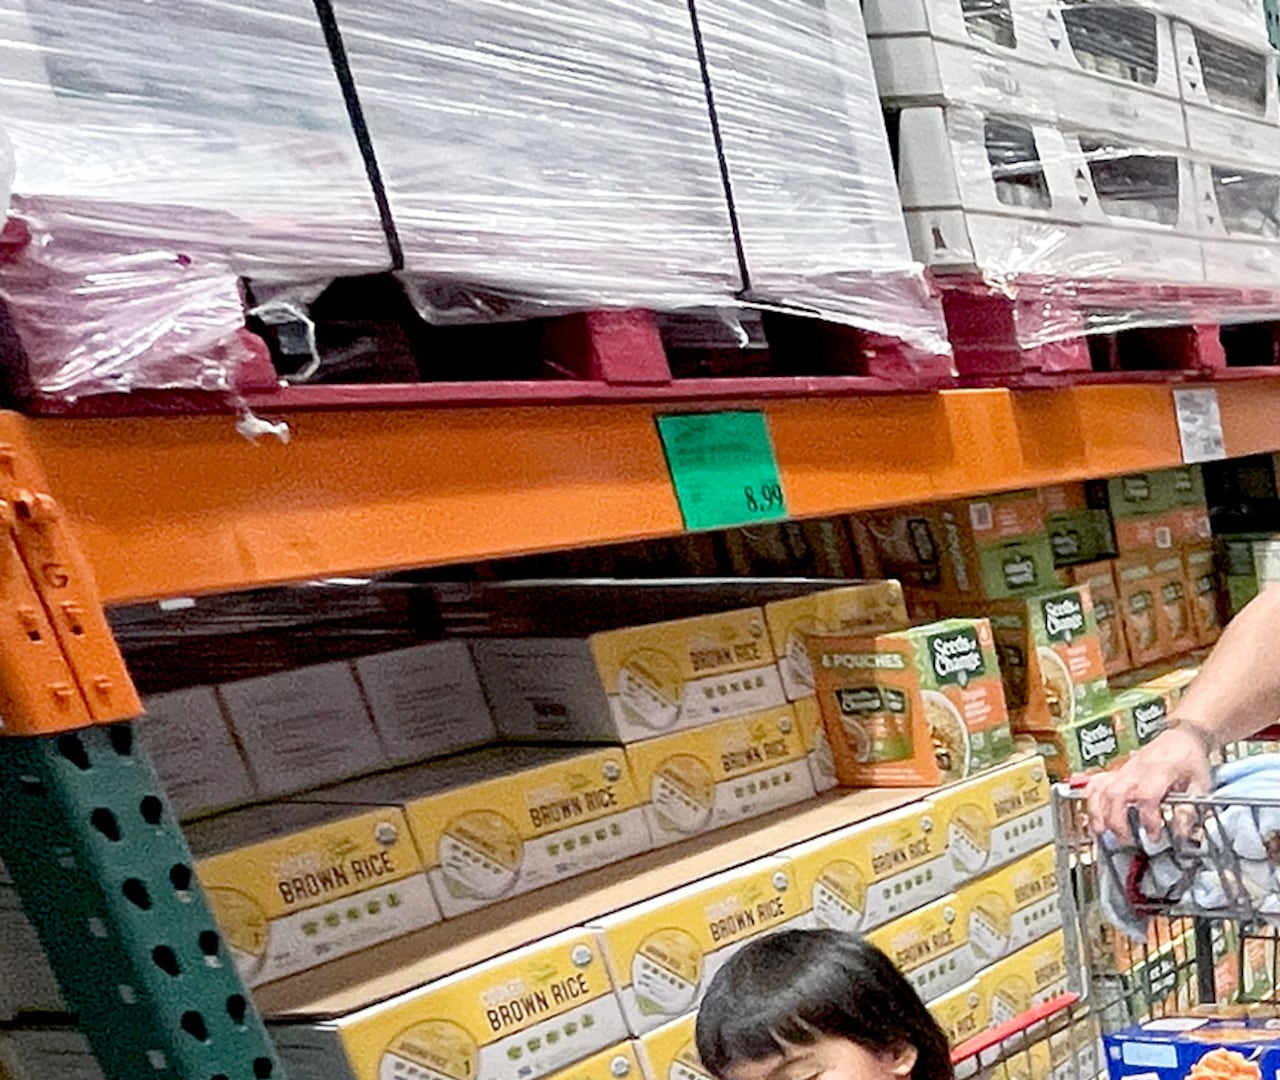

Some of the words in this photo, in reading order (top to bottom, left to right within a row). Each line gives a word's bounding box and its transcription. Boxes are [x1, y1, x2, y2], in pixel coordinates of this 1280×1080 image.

[743, 482, 784, 513] 8.99
[833, 652, 905, 669] POUCHES
[933, 637, 971, 655] Seeds
[934, 652, 983, 677] Change
[722, 750, 764, 773] BROWN
[763, 738, 791, 760] RICE
[529, 797, 583, 828] BROWN
[585, 786, 618, 813] RICE
[871, 850, 908, 876] BROWN
[908, 836, 933, 860] RICE
[278, 866, 348, 905] BROWN
[354, 851, 396, 883] RICE
[710, 911, 756, 943] BROWN
[757, 896, 786, 925] RICE
[931, 926, 956, 951] RICE
[486, 989, 550, 1032] BROWN
[550, 972, 590, 1006] RICE
